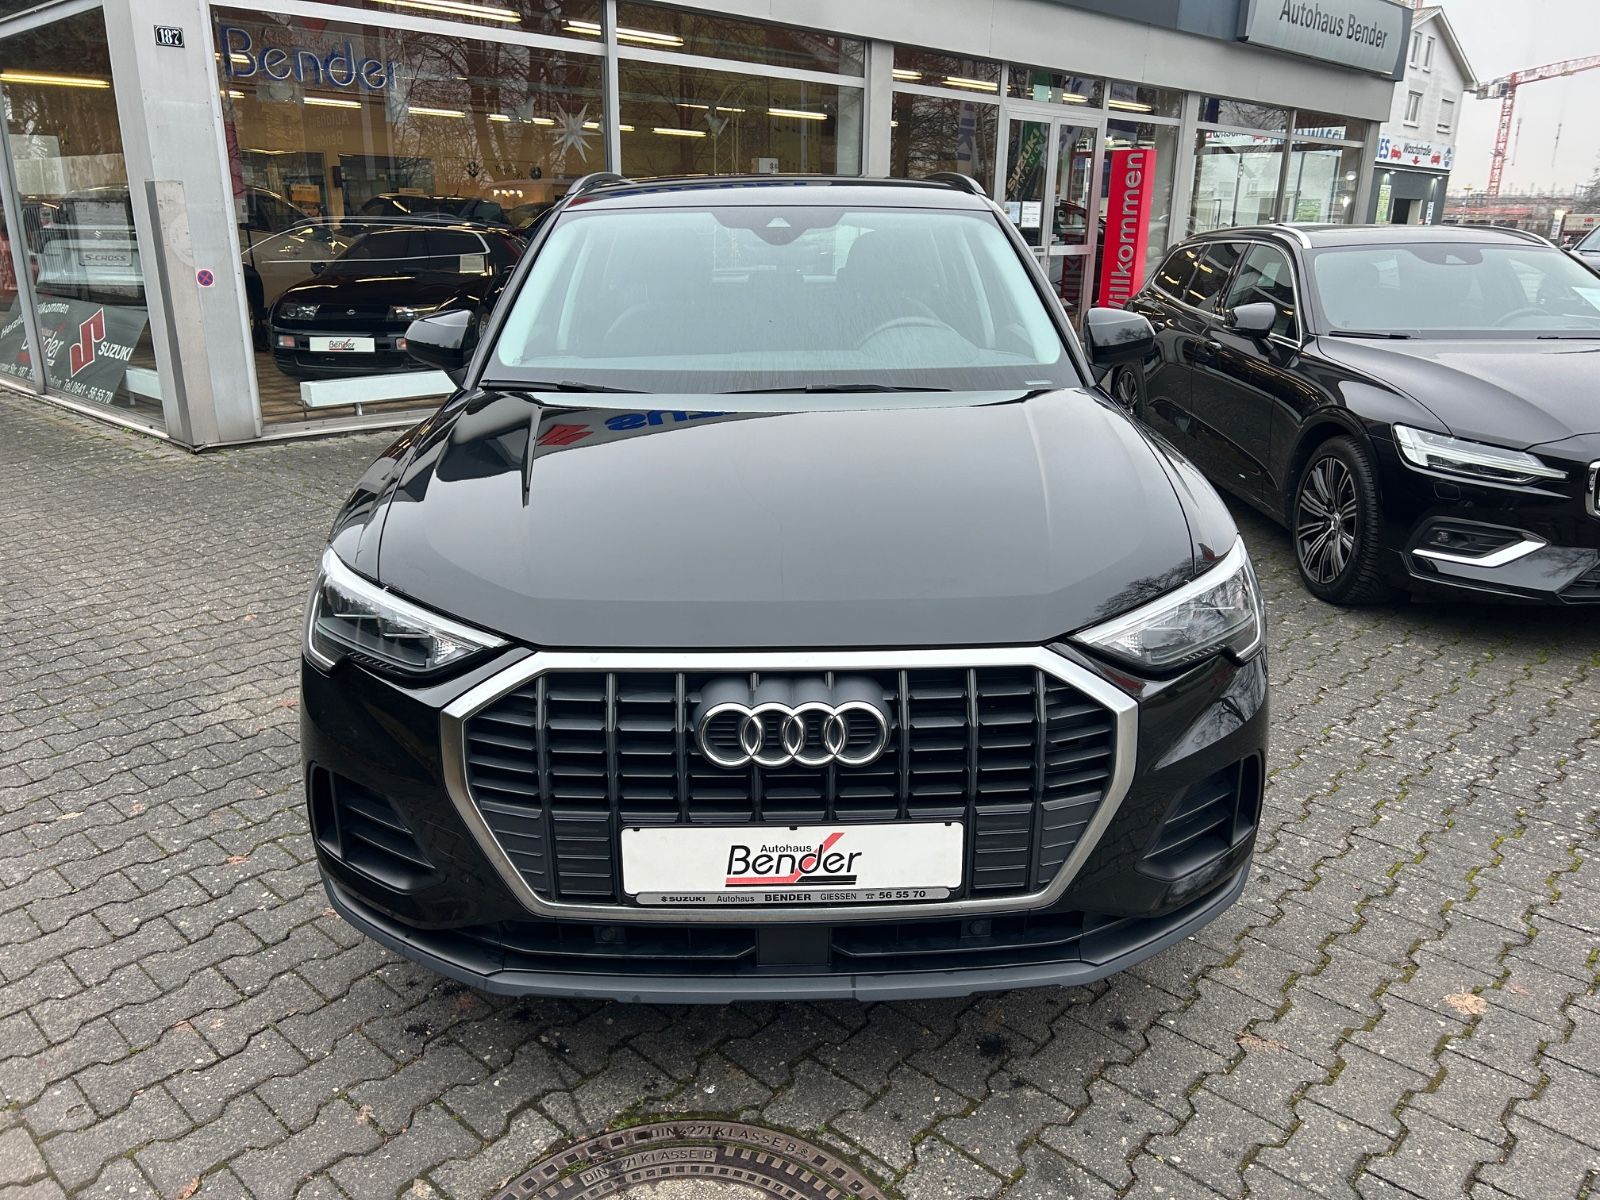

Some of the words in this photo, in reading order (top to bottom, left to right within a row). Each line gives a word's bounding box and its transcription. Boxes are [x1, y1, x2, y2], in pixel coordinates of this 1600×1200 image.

[1279, 0, 1345, 37] Autohaus
[1346, 13, 1388, 49] Bender
[158, 28, 182, 45] 187
[219, 23, 402, 92] Bender
[1007, 128, 1041, 191] SUZUKI
[85, 254, 127, 262] S-CROSS
[98, 341, 133, 361] SUZUKI
[329, 339, 355, 349] Bender
[97, 389, 106, 401] 55
[104, 391, 113, 404] 70
[760, 844, 812, 853] Autohaus
[727, 844, 863, 875] Bender
[716, 895, 755, 903] Autohaus
[764, 893, 812, 902] BENDER
[820, 892, 857, 901] GIESSEN
[878, 891, 892, 899] 56
[895, 891, 909, 899] 55
[912, 890, 926, 898] 70
[651, 1126, 677, 1138] DIN
[715, 1126, 785, 1147] KLASSE
[785, 1142, 797, 1153] B
[583, 1167, 608, 1182] DIN
[640, 1149, 698, 1164] KLASSE
[703, 1149, 713, 1159] B
